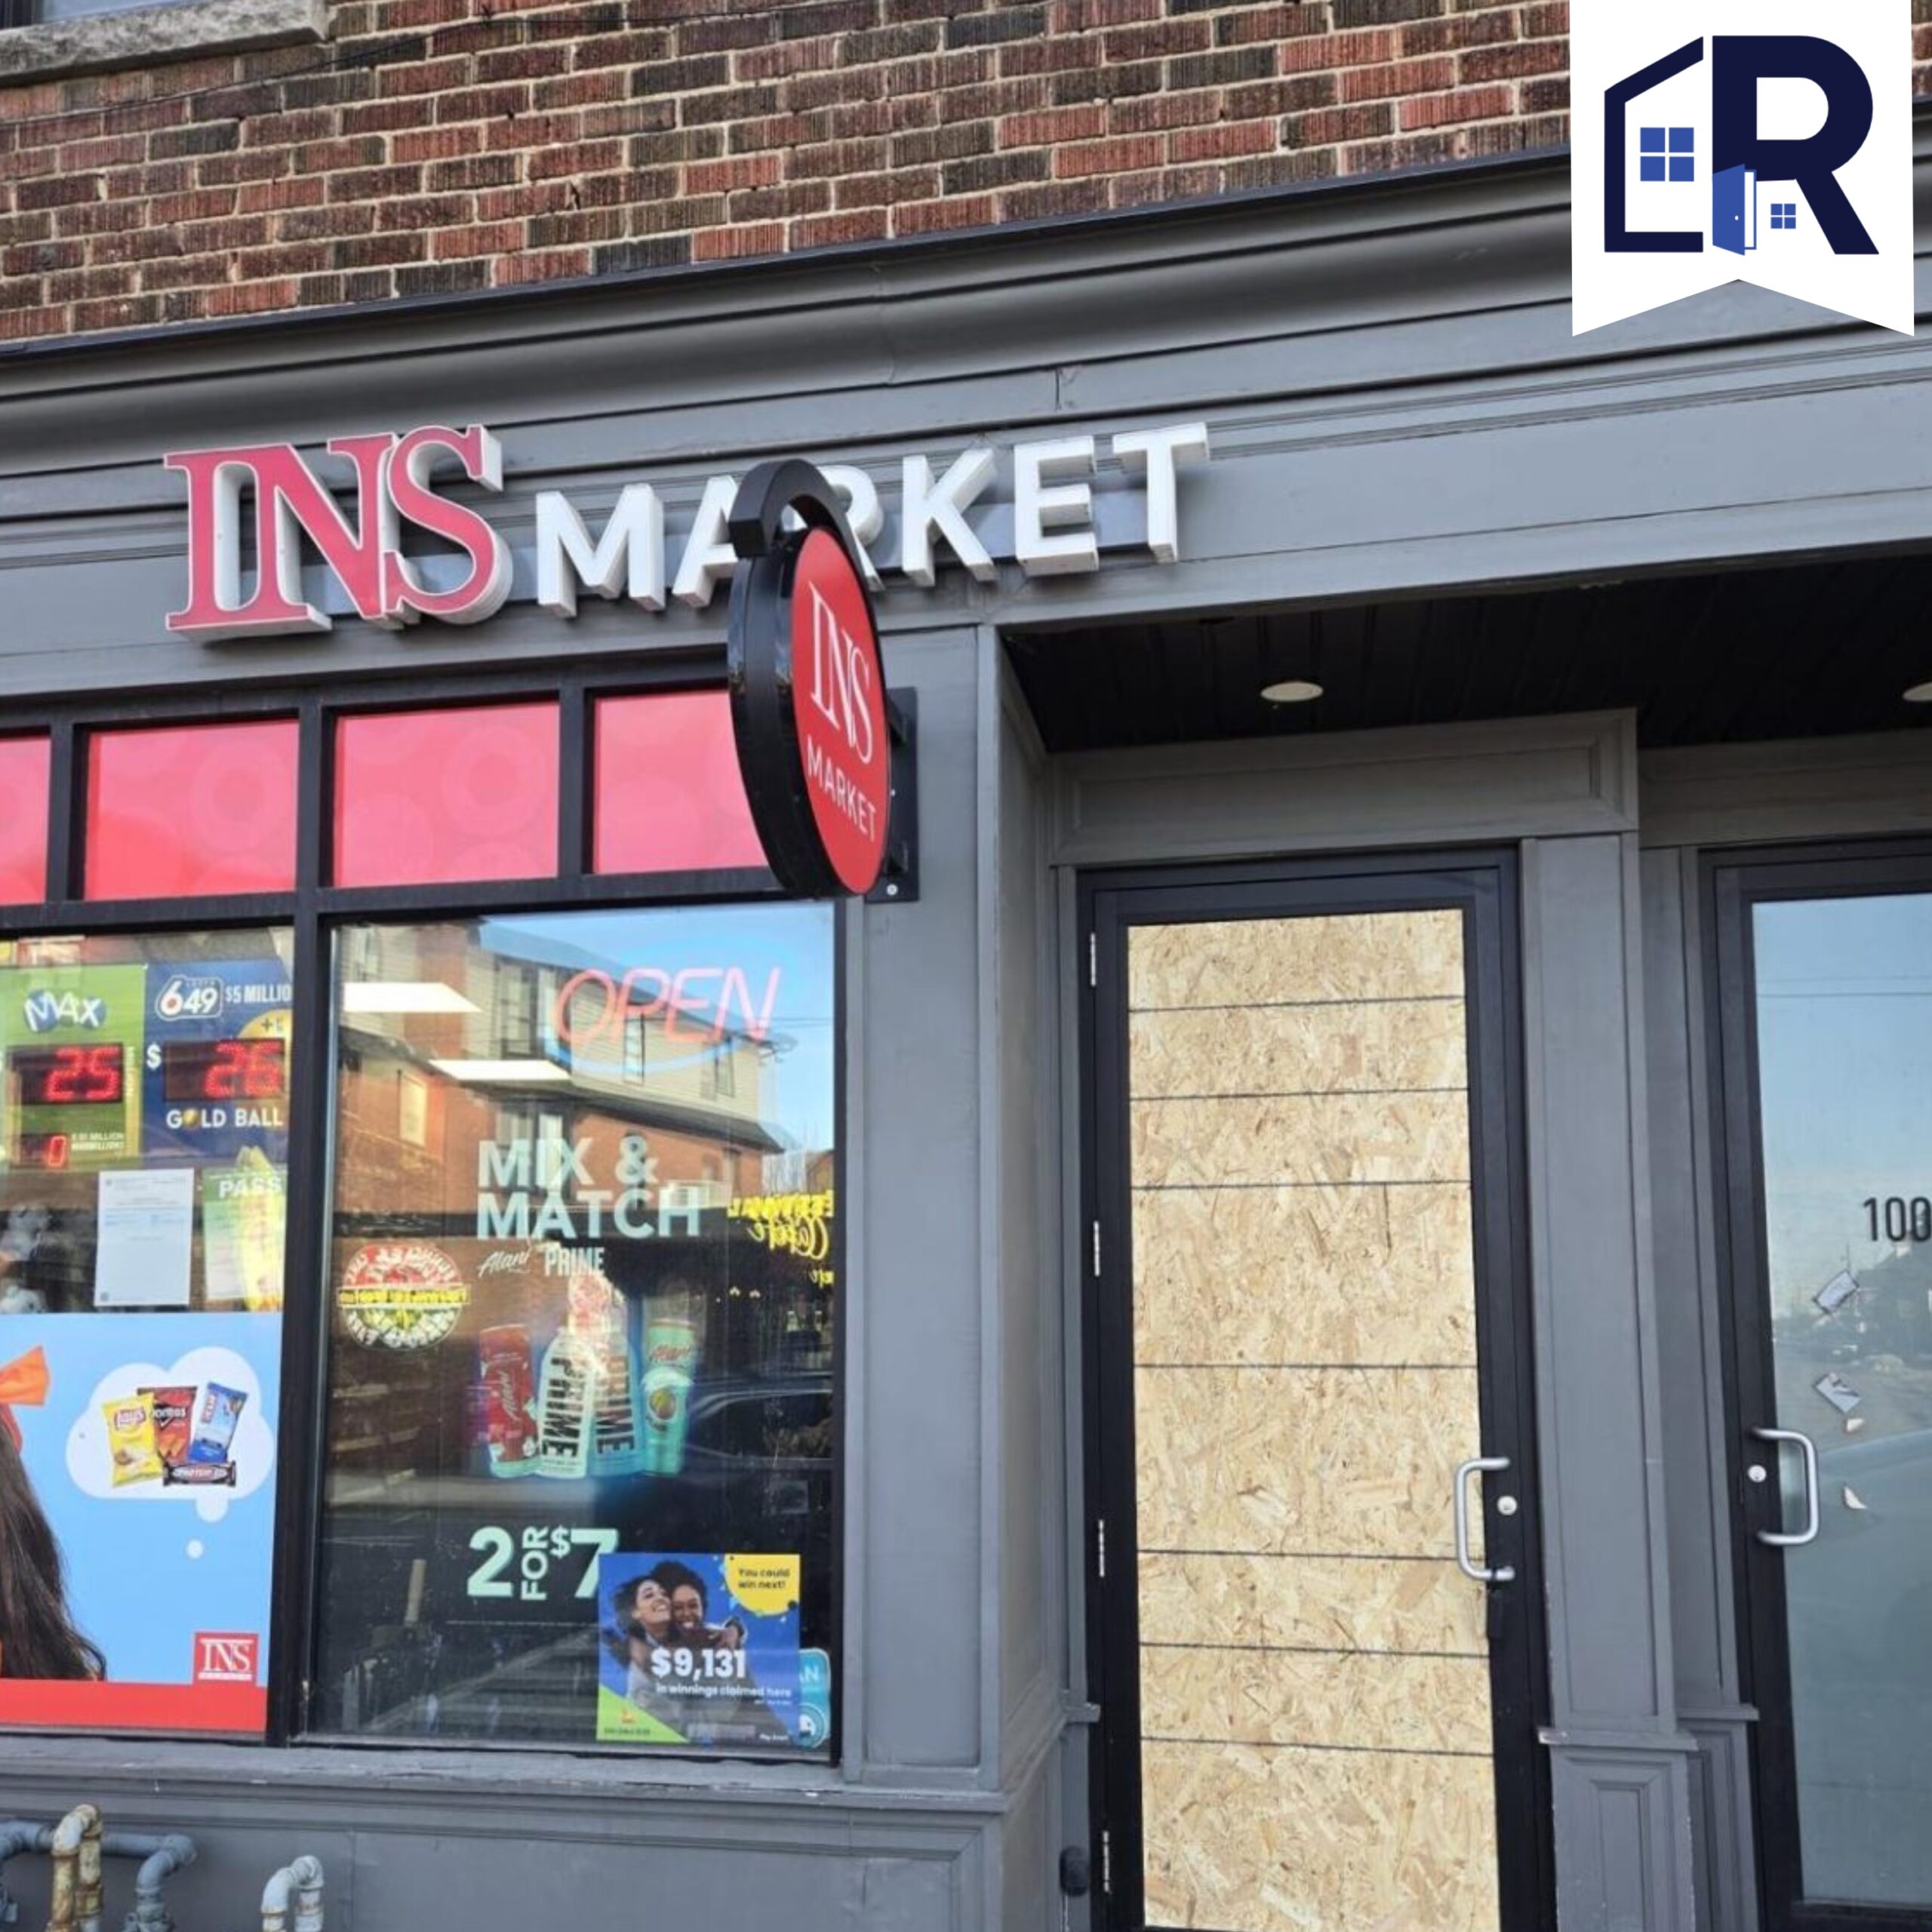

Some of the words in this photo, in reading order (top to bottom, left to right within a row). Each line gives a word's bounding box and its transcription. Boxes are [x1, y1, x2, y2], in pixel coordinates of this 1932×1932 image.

[163, 424, 507, 631] INS
[535, 422, 1208, 617] MARKET
[811, 581, 873, 764] INS
[807, 734, 877, 842] MARKET
[24, 990, 102, 1032] MAX
[552, 967, 780, 1044] OPEN
[46, 1046, 120, 1103] 25
[205, 1041, 282, 1099] 26
[235, 1107, 283, 1127] BALL
[478, 1137, 593, 1188] MIX
[615, 1135, 659, 1185] &
[476, 1188, 700, 1239] MATCH
[544, 1247, 605, 1277] PRIME
[467, 1526, 514, 1596] 2
[521, 1526, 549, 1600] FOR
[200, 1638, 254, 1674] INS
[651, 1647, 746, 1681] $9,131
[669, 1684, 718, 1697] winnings
[720, 1684, 764, 1696] claimed
